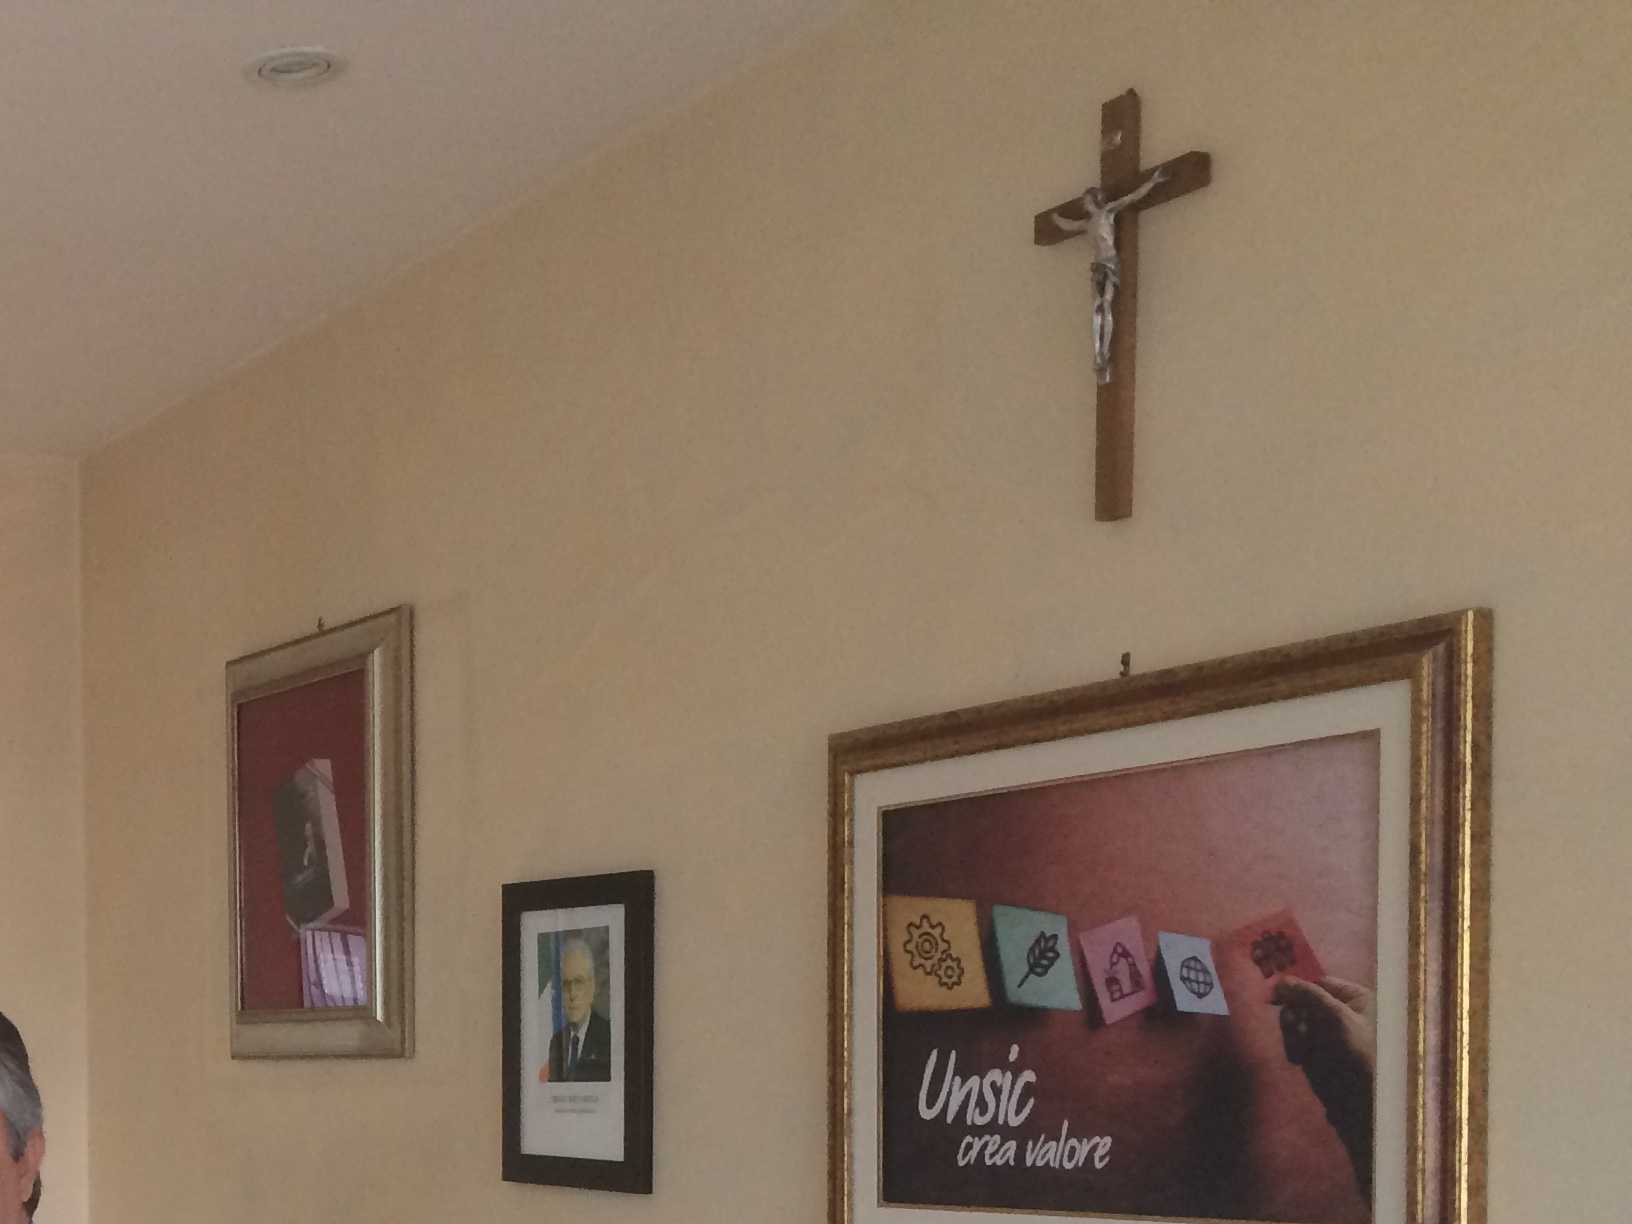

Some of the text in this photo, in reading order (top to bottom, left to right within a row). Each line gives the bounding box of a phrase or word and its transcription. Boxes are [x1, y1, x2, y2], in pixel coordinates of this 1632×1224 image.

[918, 1043, 1037, 1127] Unsic
[958, 1119, 1113, 1170] crea valore
